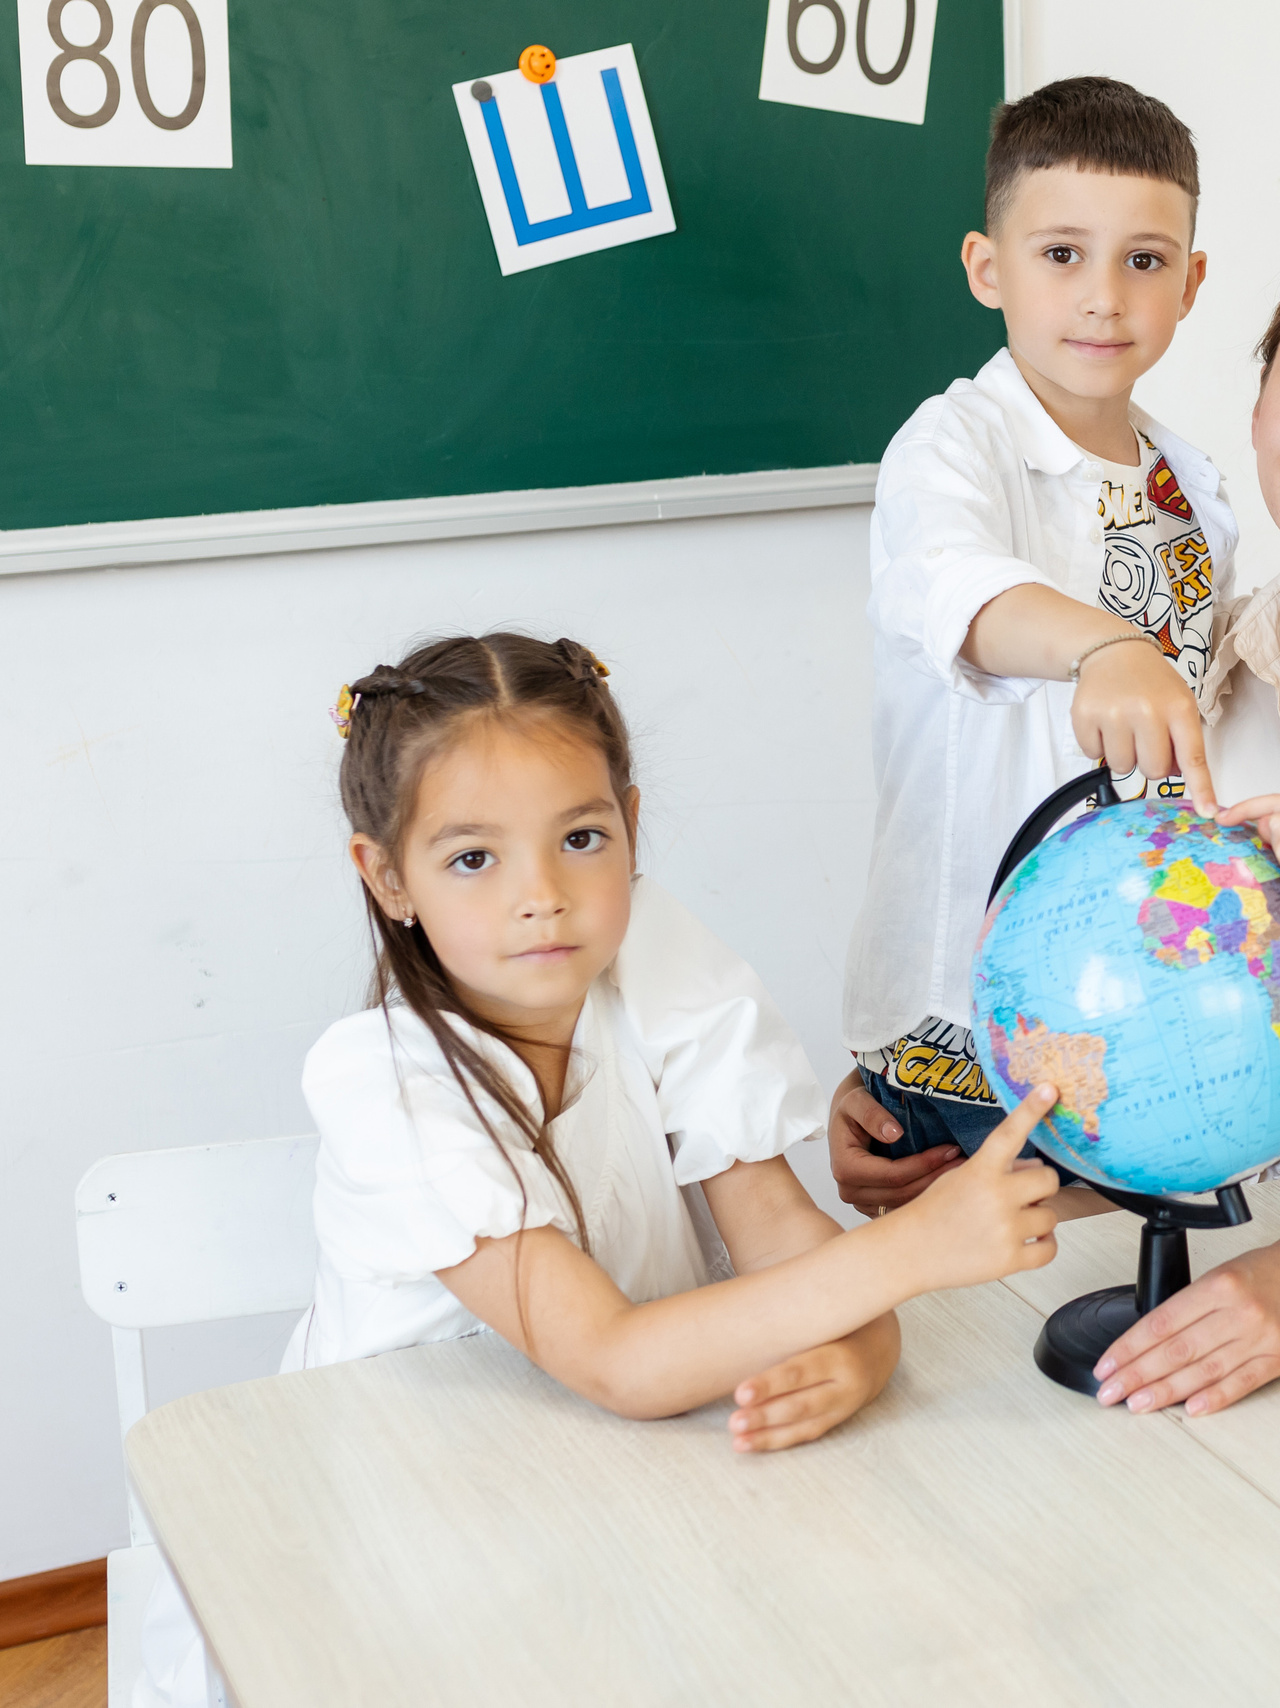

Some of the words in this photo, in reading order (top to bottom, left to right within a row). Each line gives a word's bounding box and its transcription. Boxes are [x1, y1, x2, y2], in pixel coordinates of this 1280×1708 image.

[46, 0, 206, 131] 80
[787, 0, 915, 86] 60
[479, 67, 652, 246] Ш
